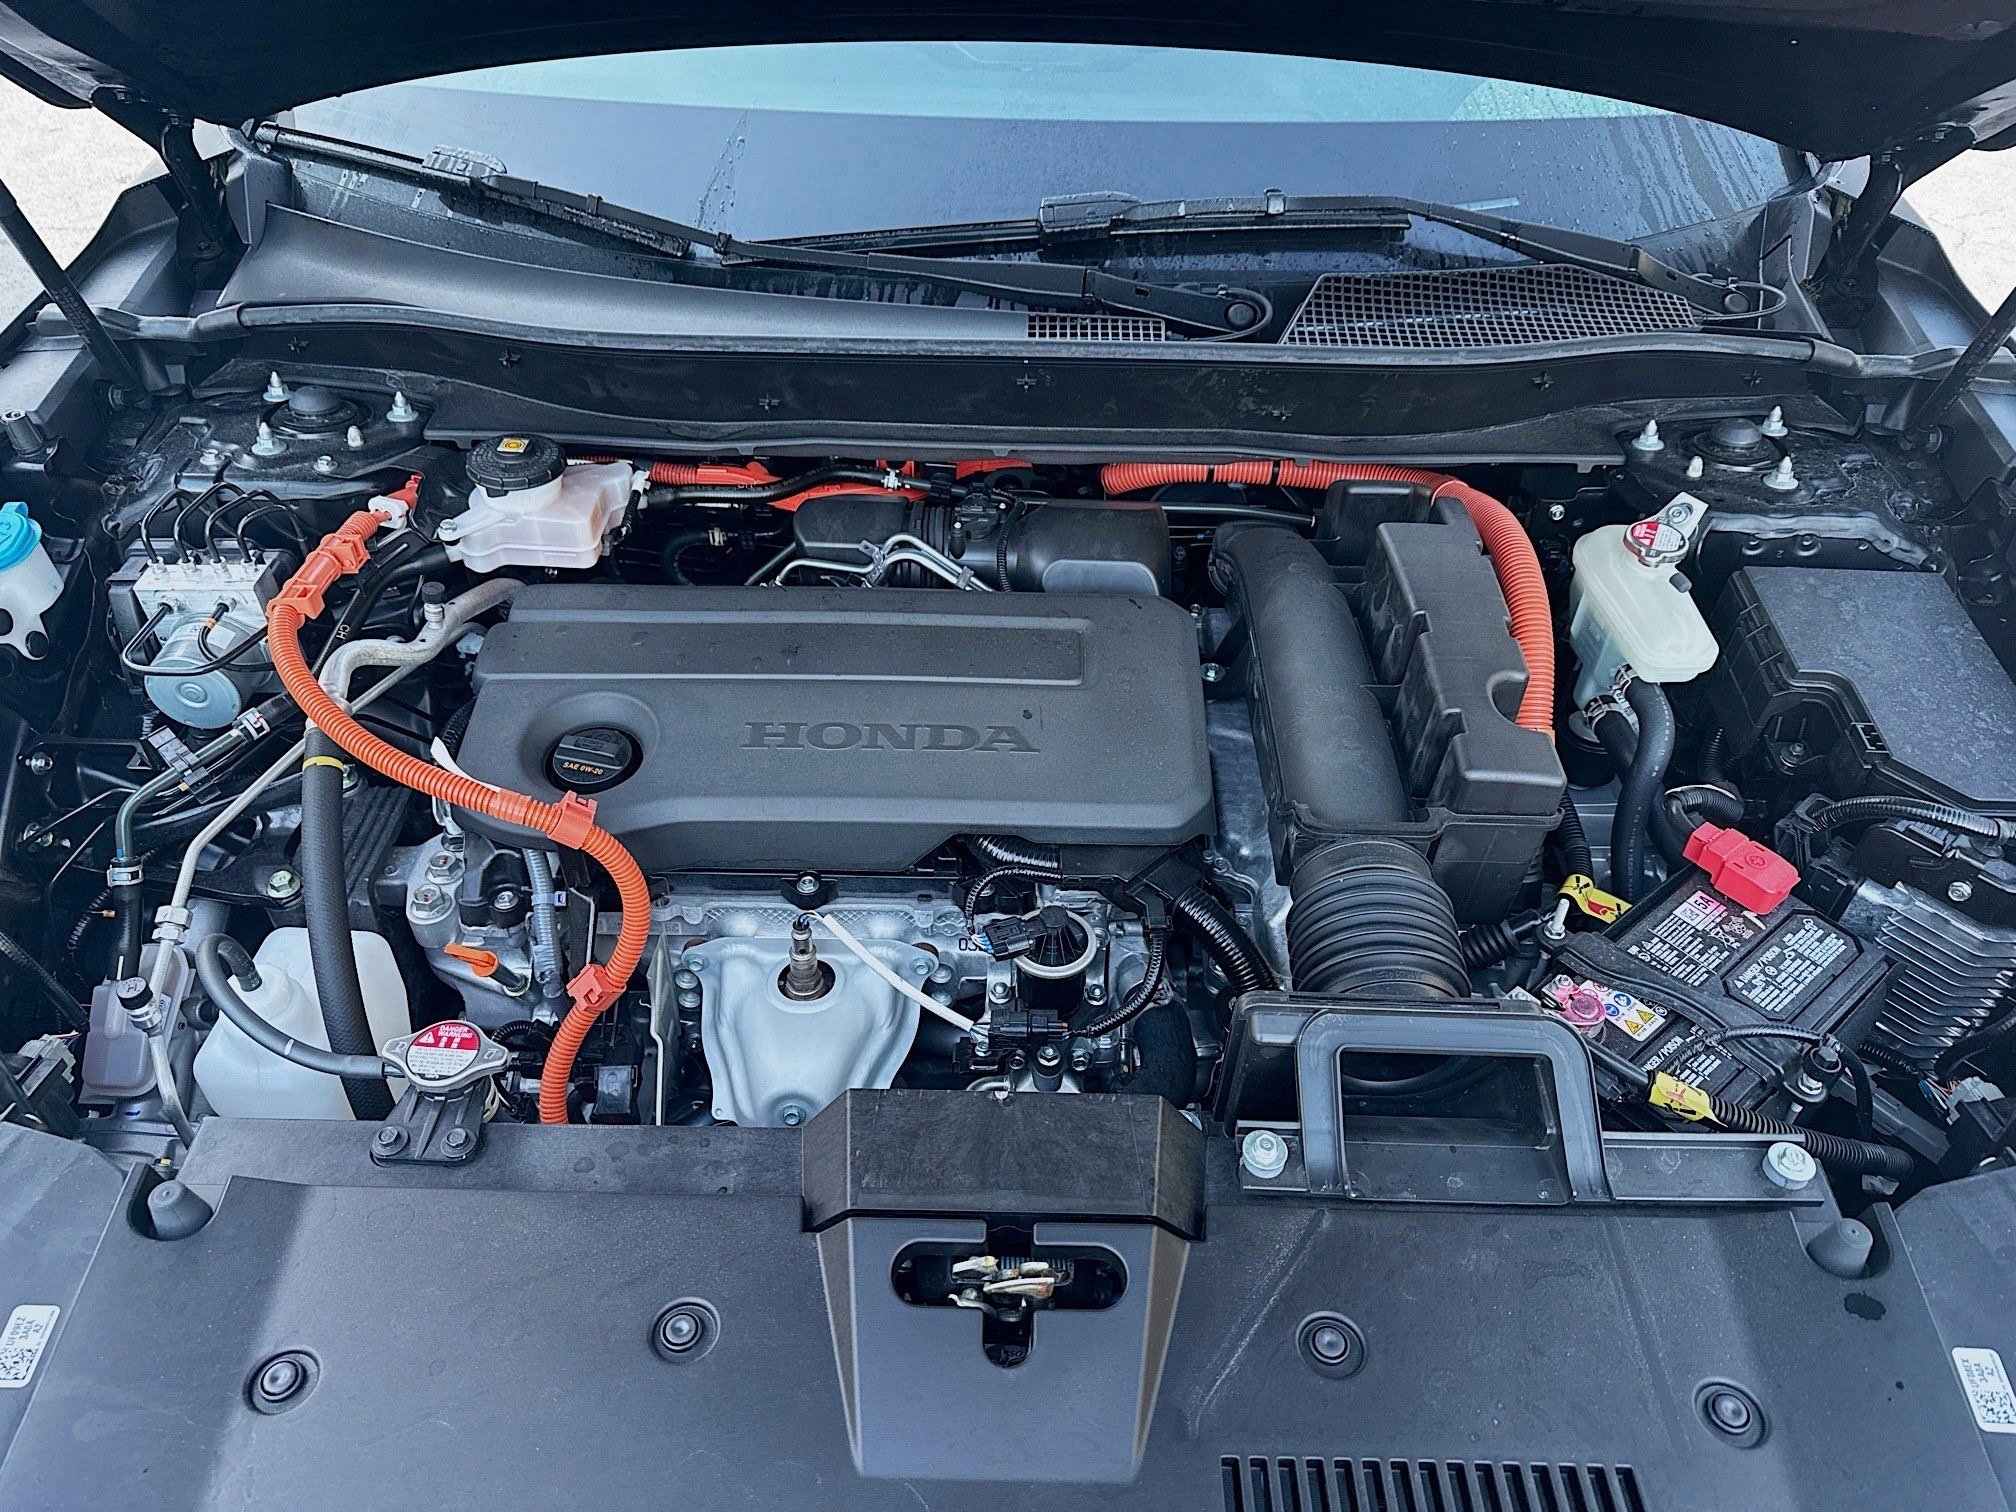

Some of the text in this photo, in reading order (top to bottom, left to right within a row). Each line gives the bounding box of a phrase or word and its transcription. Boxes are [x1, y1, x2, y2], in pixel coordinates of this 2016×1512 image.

[741, 721, 1040, 754] HONDA
[562, 761, 604, 775] SAE 0W-20
[1693, 895, 1715, 910] 5A
[439, 1024, 469, 1034] DANGER
